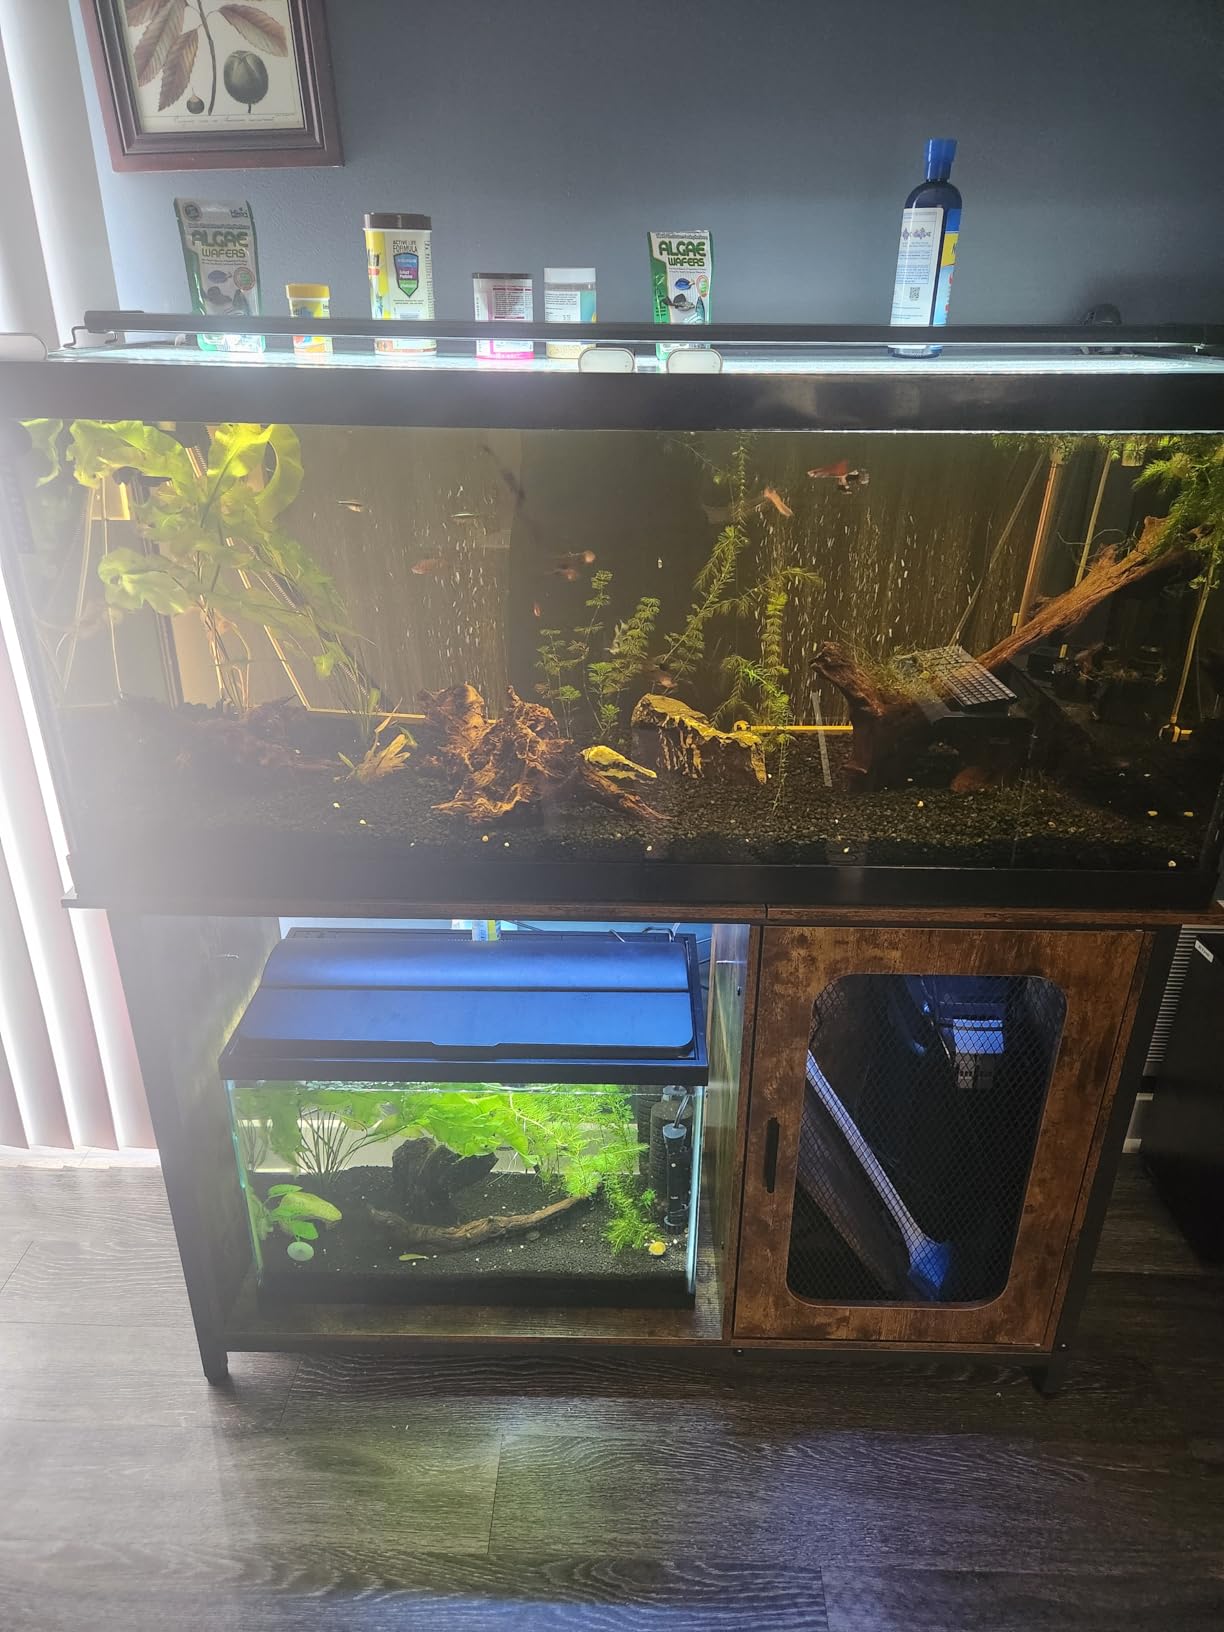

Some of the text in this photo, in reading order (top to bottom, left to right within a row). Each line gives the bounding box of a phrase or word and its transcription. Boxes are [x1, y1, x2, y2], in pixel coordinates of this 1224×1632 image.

[191, 230, 249, 248] ALGAE
[202, 248, 246, 258] WAFERS
[658, 240, 706, 257] ALGAE
[668, 257, 705, 267] WAFERS
